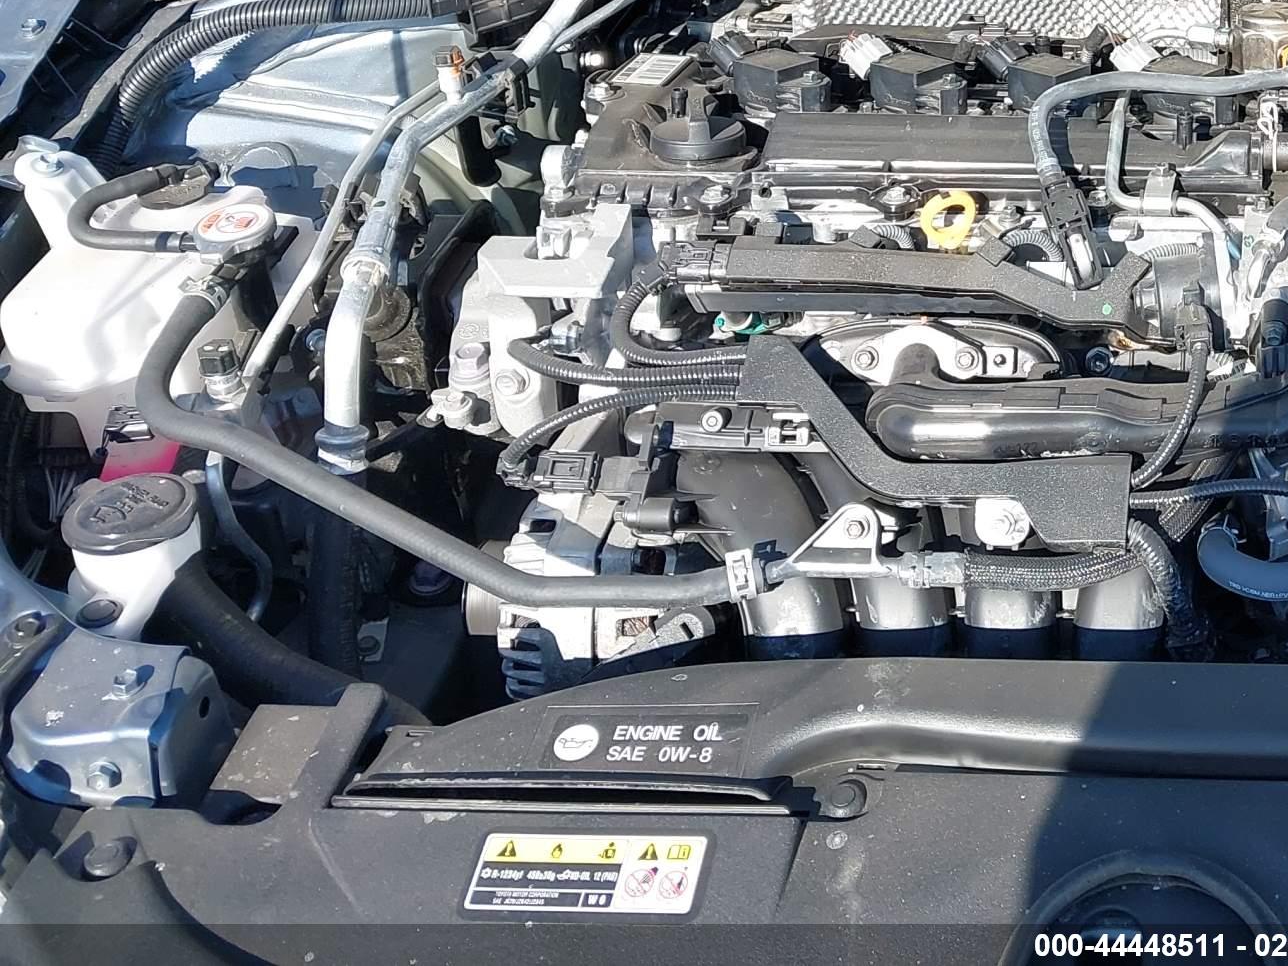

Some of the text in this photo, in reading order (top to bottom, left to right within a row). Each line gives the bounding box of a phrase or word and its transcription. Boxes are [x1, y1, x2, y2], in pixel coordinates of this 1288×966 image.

[612, 724, 723, 741] ENGINE OIL
[606, 745, 713, 763] SAE 0W-8
